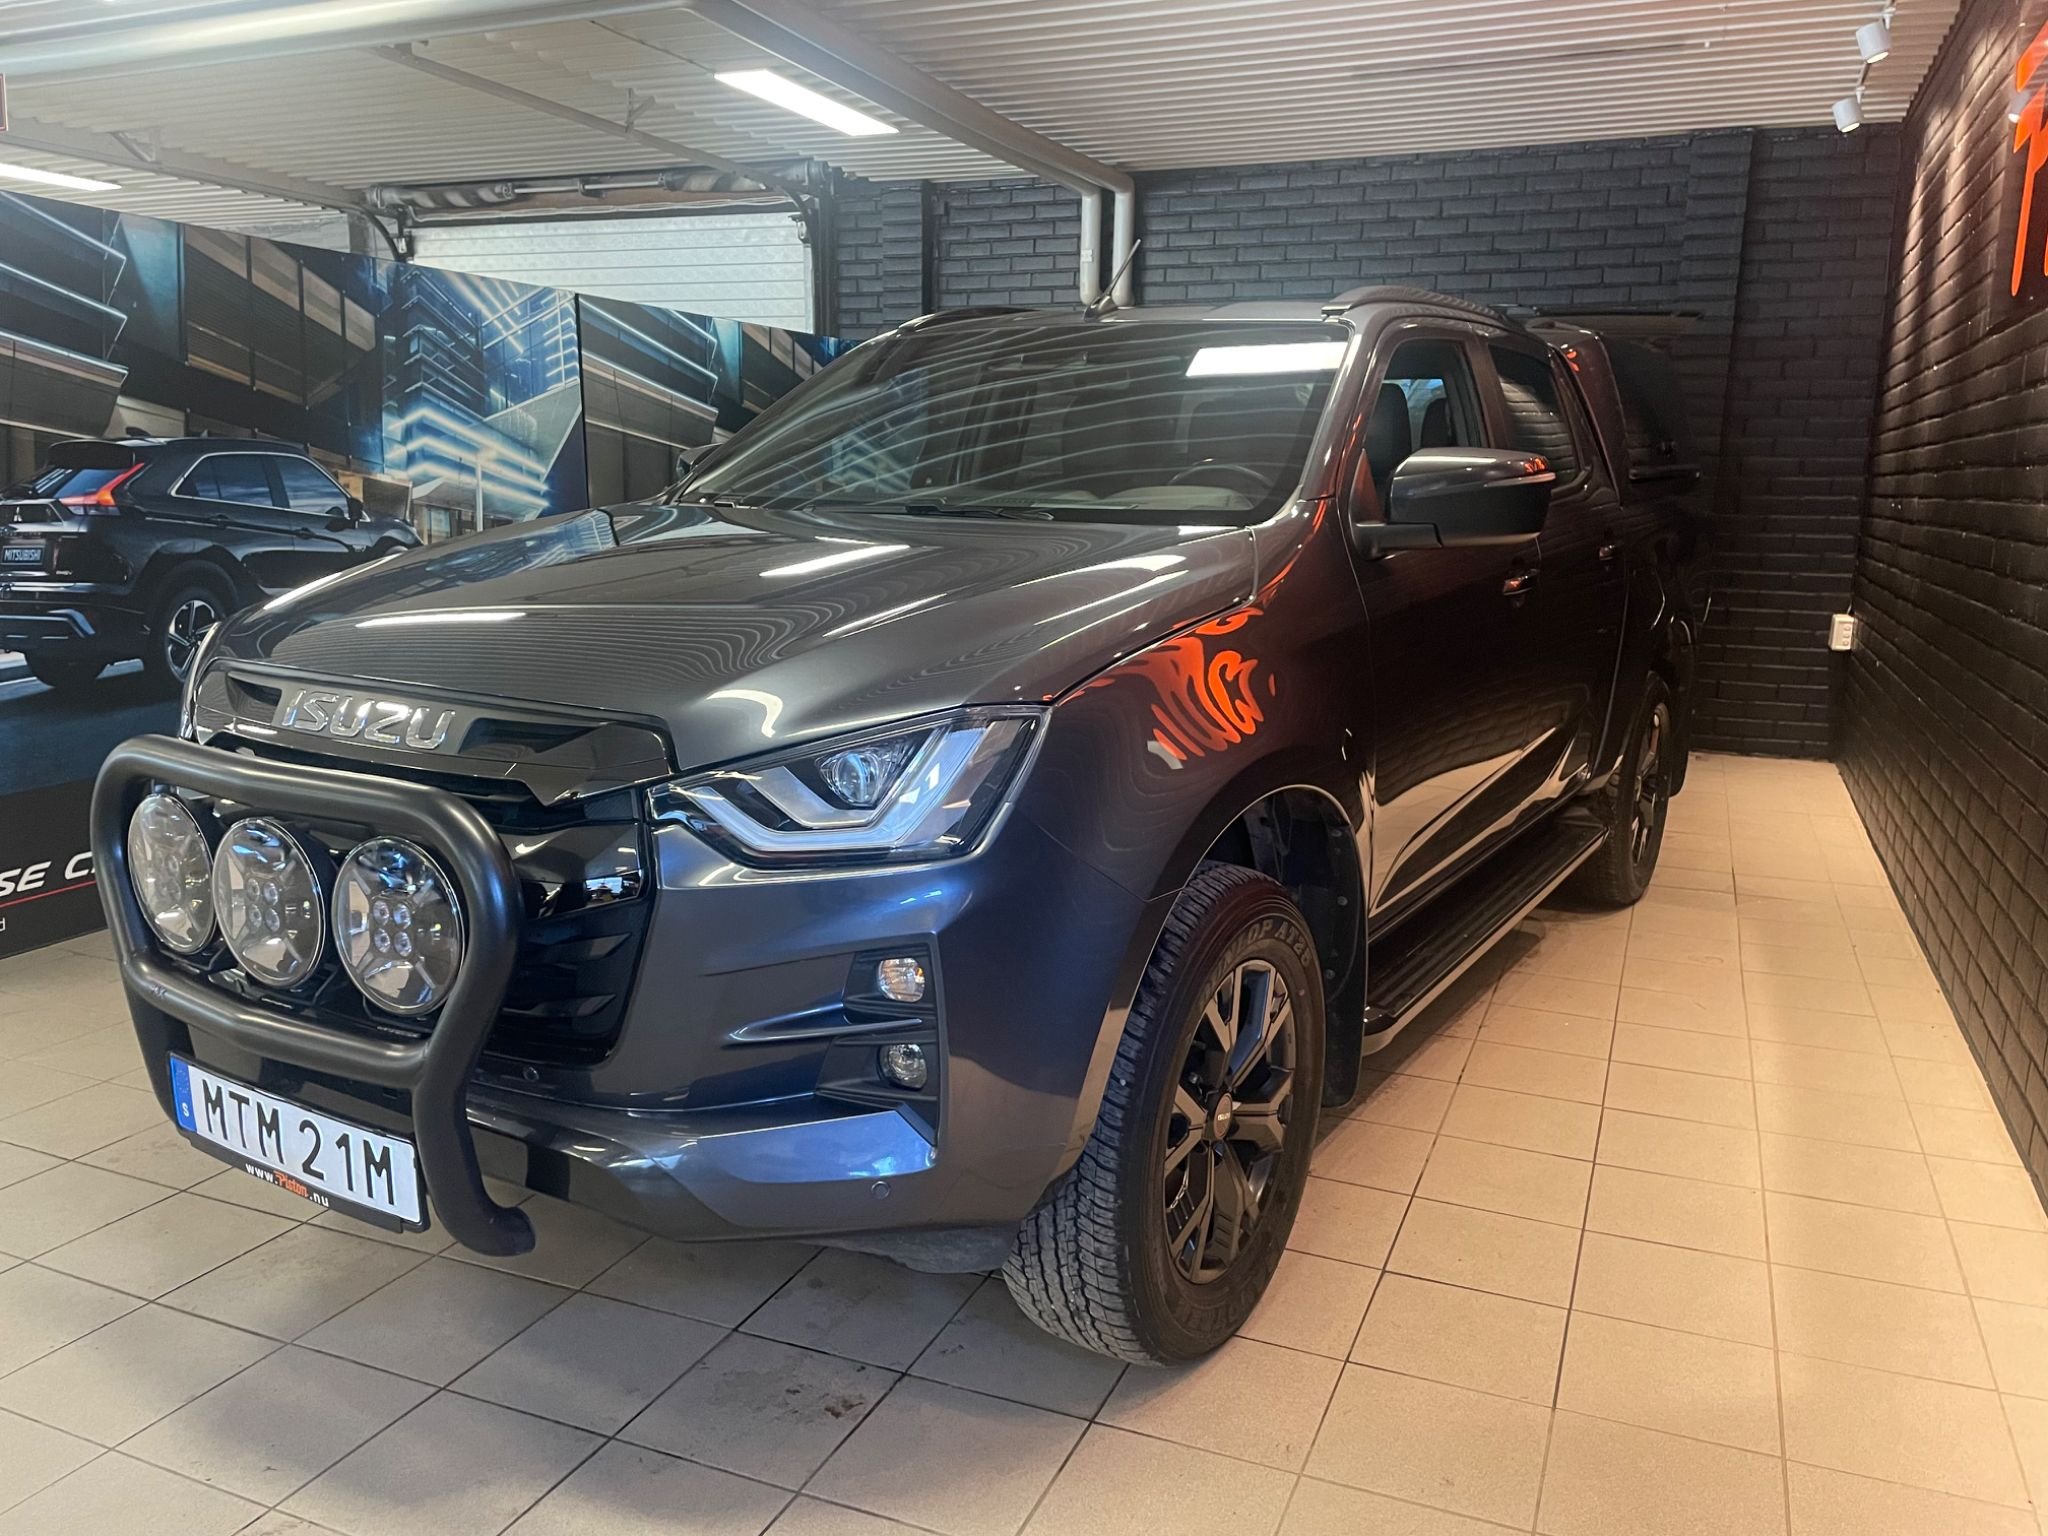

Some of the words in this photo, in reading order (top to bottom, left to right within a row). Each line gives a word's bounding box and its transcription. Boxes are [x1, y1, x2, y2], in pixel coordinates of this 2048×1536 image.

[282, 689, 456, 750] ISUZU
[64, 851, 96, 880] C
[182, 1102, 190, 1118] S
[202, 1079, 285, 1164] MTM
[299, 1119, 395, 1206] 21M
